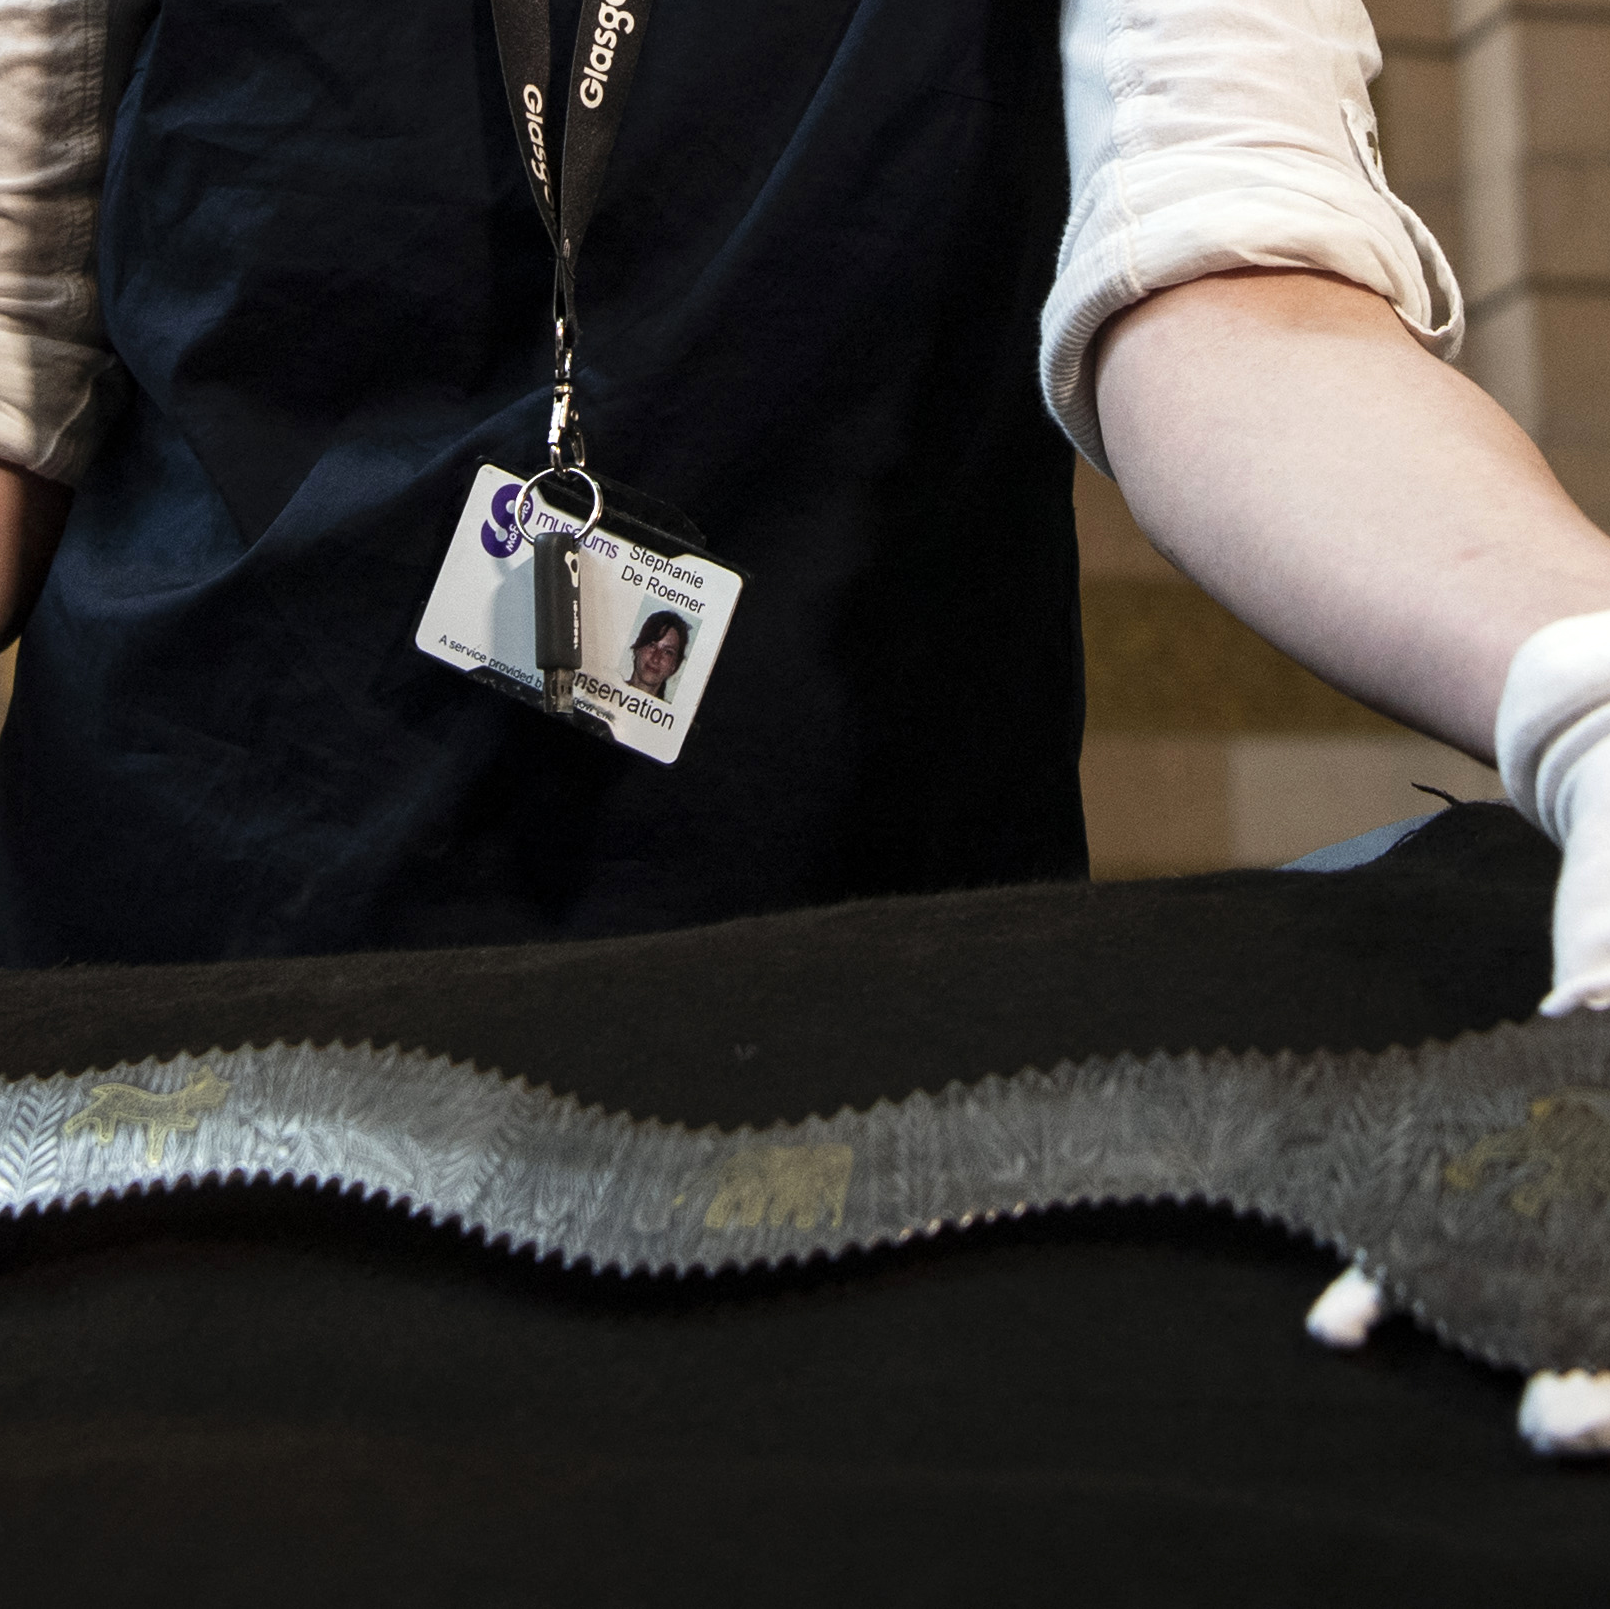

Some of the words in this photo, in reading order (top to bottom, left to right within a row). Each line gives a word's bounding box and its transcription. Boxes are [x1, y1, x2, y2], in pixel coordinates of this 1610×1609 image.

[621, 564, 644, 587] De
[647, 576, 706, 615] Roemer
[629, 543, 705, 590] Stephanie
[439, 634, 448, 646] A
[449, 640, 487, 663] service
[488, 659, 533, 686] provided
[573, 671, 675, 731] nservation
